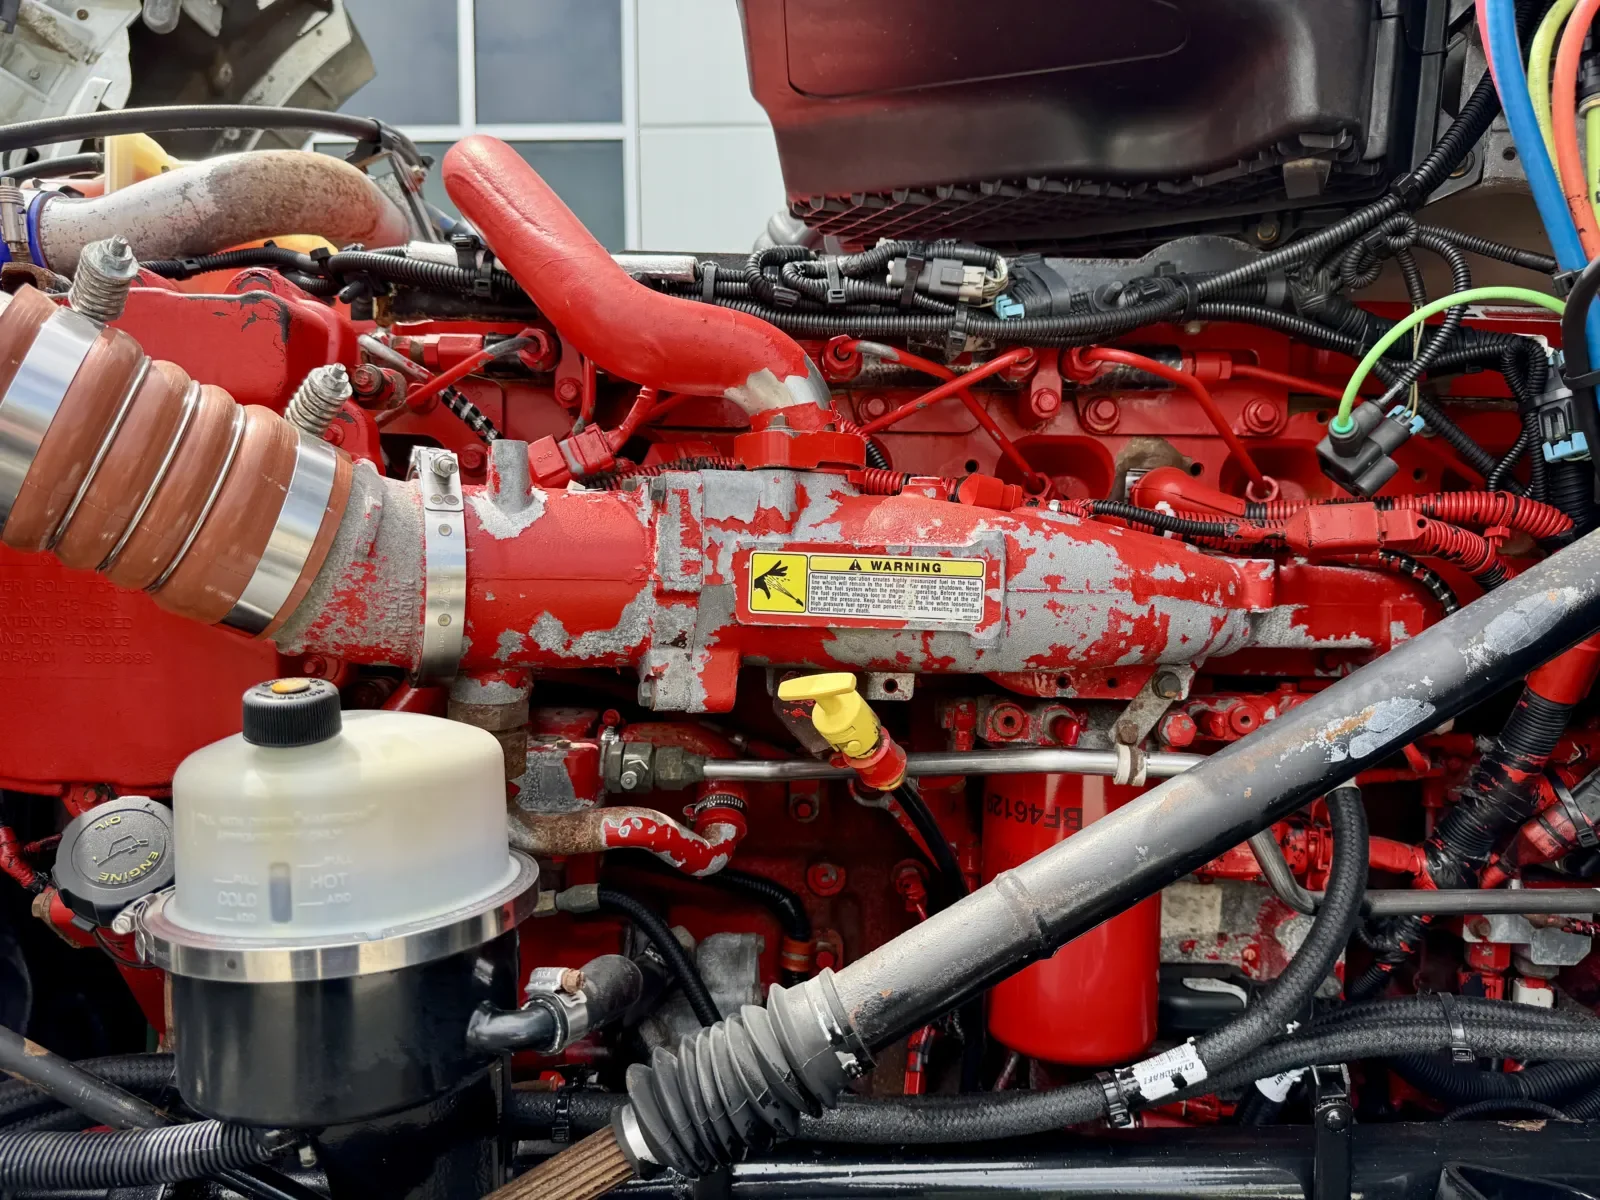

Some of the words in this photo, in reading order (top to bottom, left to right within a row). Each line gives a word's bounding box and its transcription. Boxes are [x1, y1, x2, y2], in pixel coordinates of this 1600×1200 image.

[871, 560, 942, 573] WARNING
[94, 815, 121, 831] OIL
[98, 850, 160, 882] ENGINE
[309, 872, 348, 889] HOT
[218, 891, 258, 908] COLD
[326, 893, 352, 903] ADD
[236, 912, 257, 923] ADD
